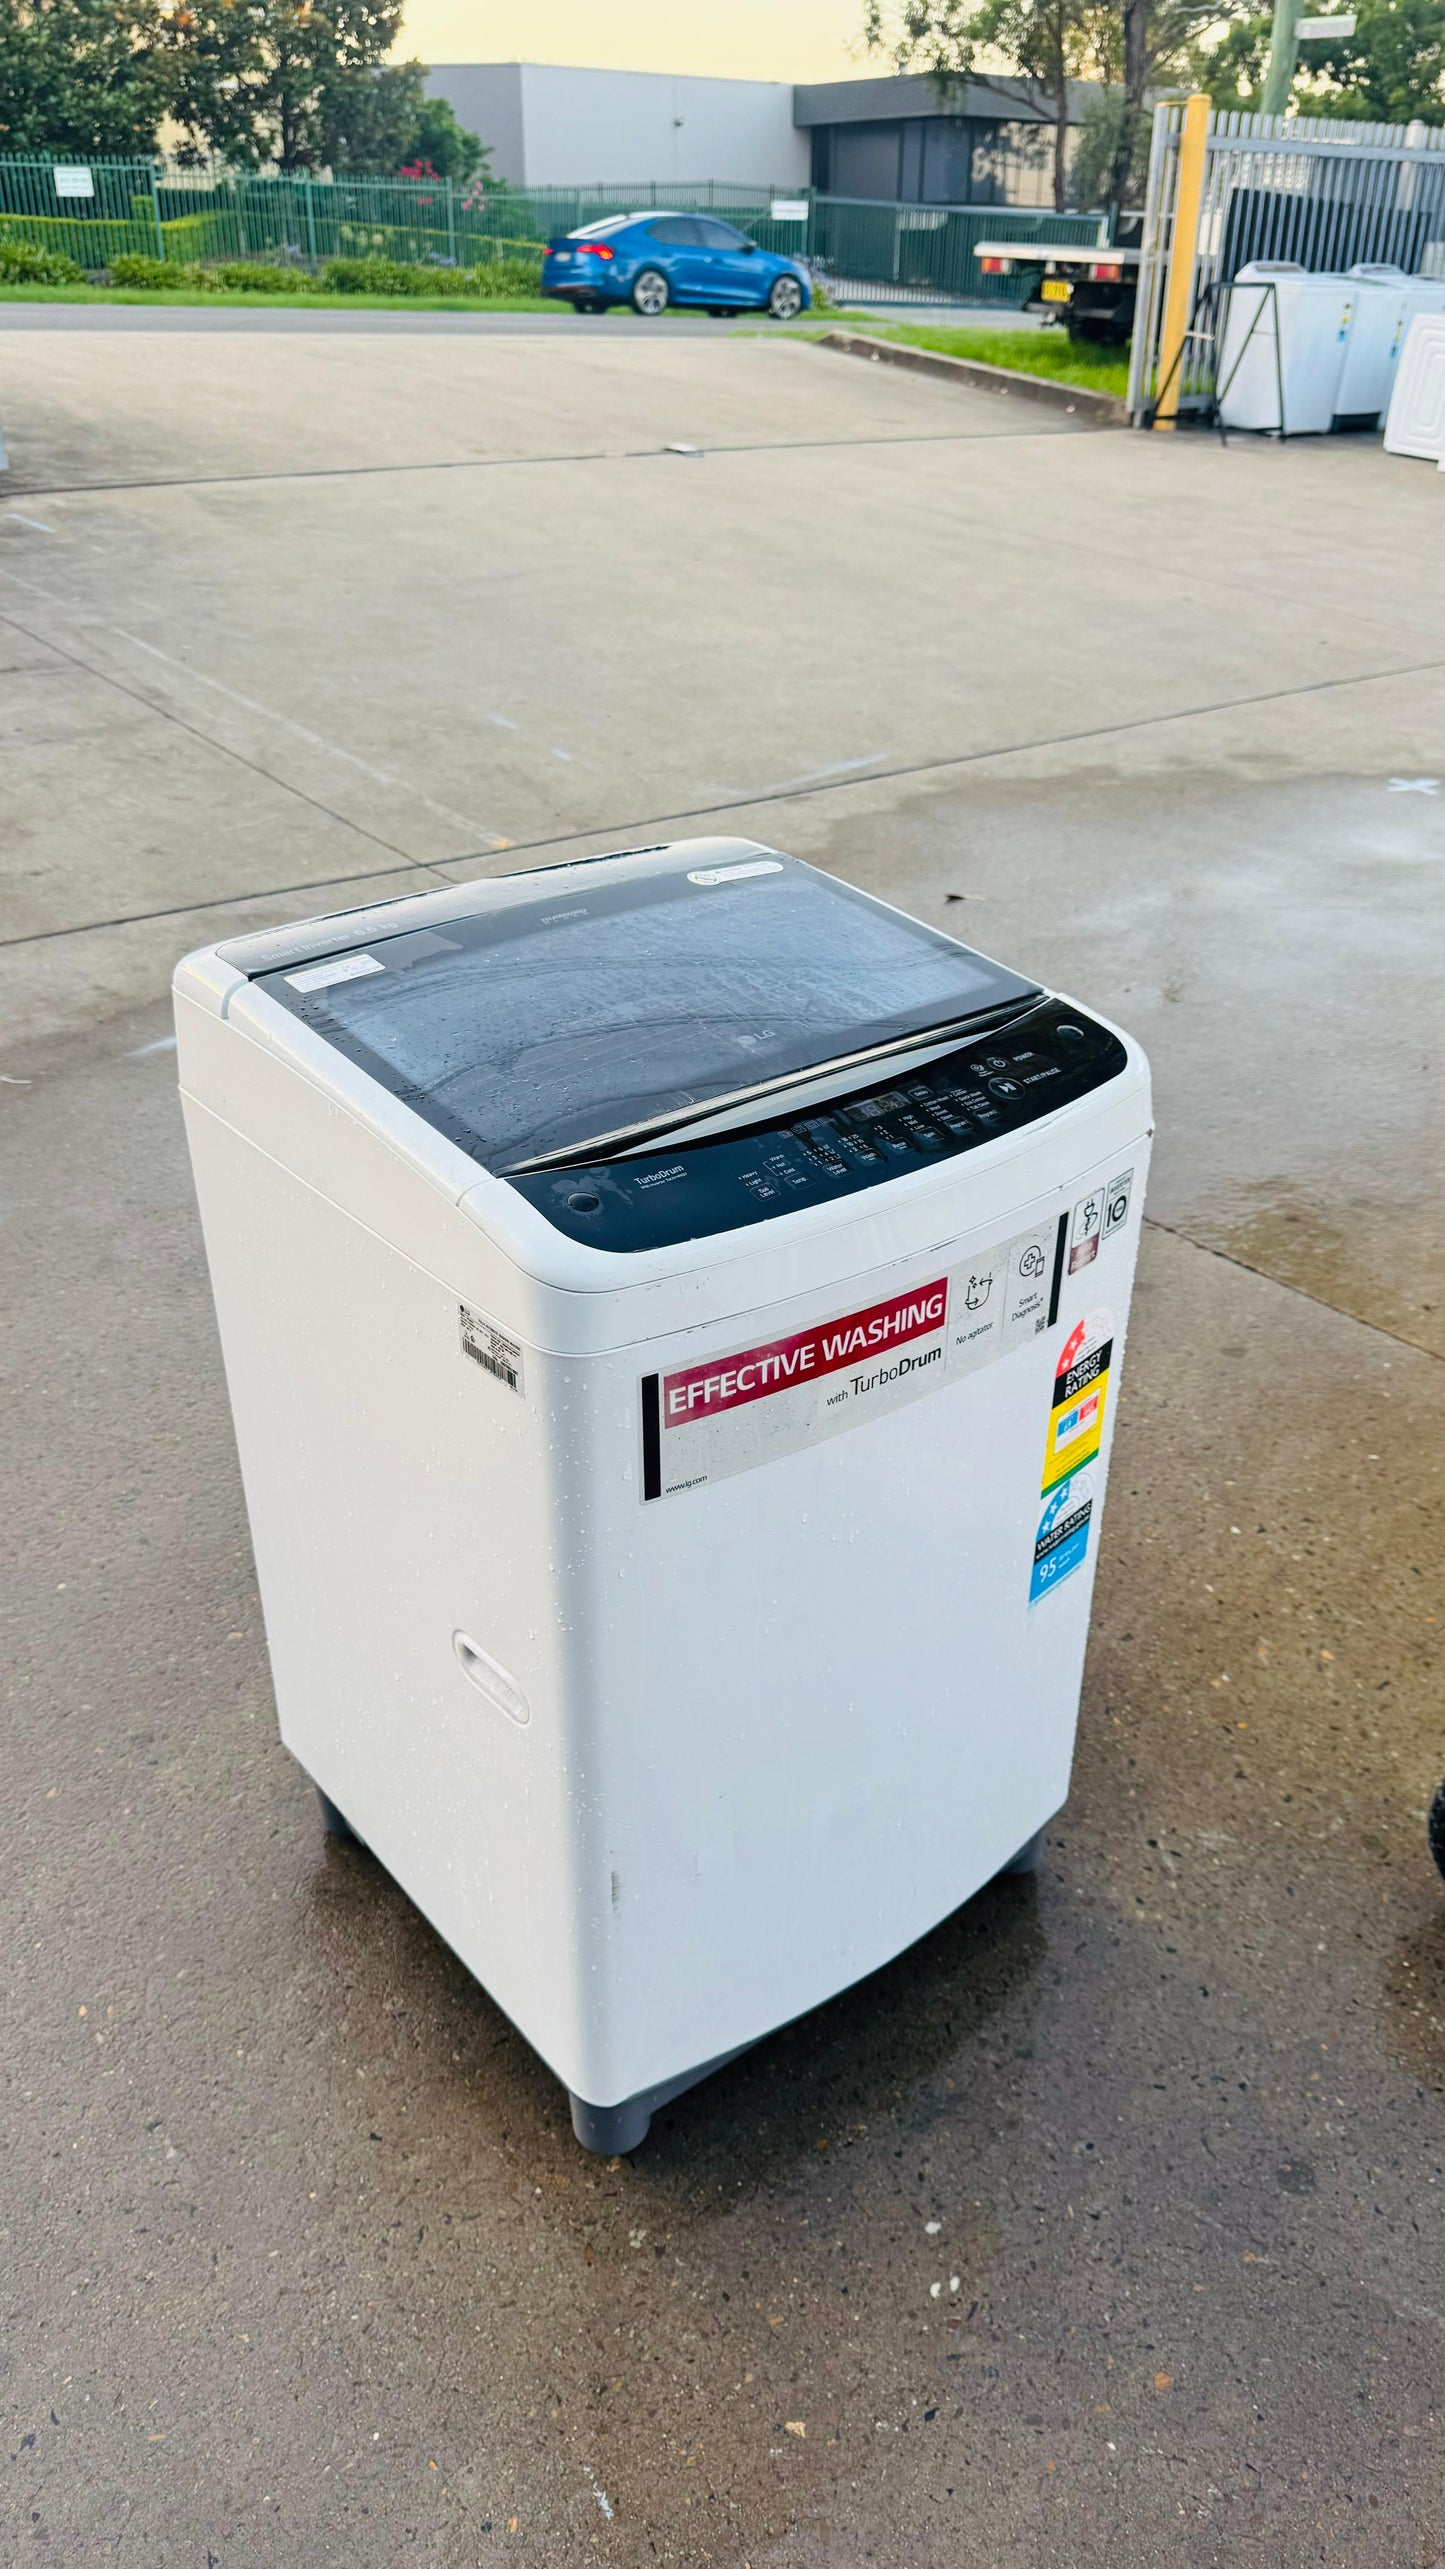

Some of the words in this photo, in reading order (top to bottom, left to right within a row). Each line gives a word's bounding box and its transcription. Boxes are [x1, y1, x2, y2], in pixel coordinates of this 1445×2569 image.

[261, 946, 300, 962] Smart
[301, 933, 351, 952] Inverter
[381, 921, 400, 931] kg
[753, 1029, 776, 1040] LG
[633, 1165, 685, 1185] TurboDrum
[1106, 1195, 1127, 1228] 10
[1018, 1292, 1038, 1308] Smart
[955, 1335, 967, 1346] No
[967, 1321, 994, 1341] agitator
[668, 1343, 816, 1416] EFFECTIVE
[821, 1293, 944, 1362] WASHING
[1066, 1349, 1103, 1385] ENERGY
[826, 1389, 849, 1407] with
[849, 1347, 942, 1396] TurboDrum
[1065, 1363, 1101, 1399] RATING
[665, 1474, 708, 1494] www.lg.com
[1036, 1525, 1064, 1551] WATER
[1063, 1502, 1092, 1530] RATING
[1040, 1556, 1057, 1583] 95
